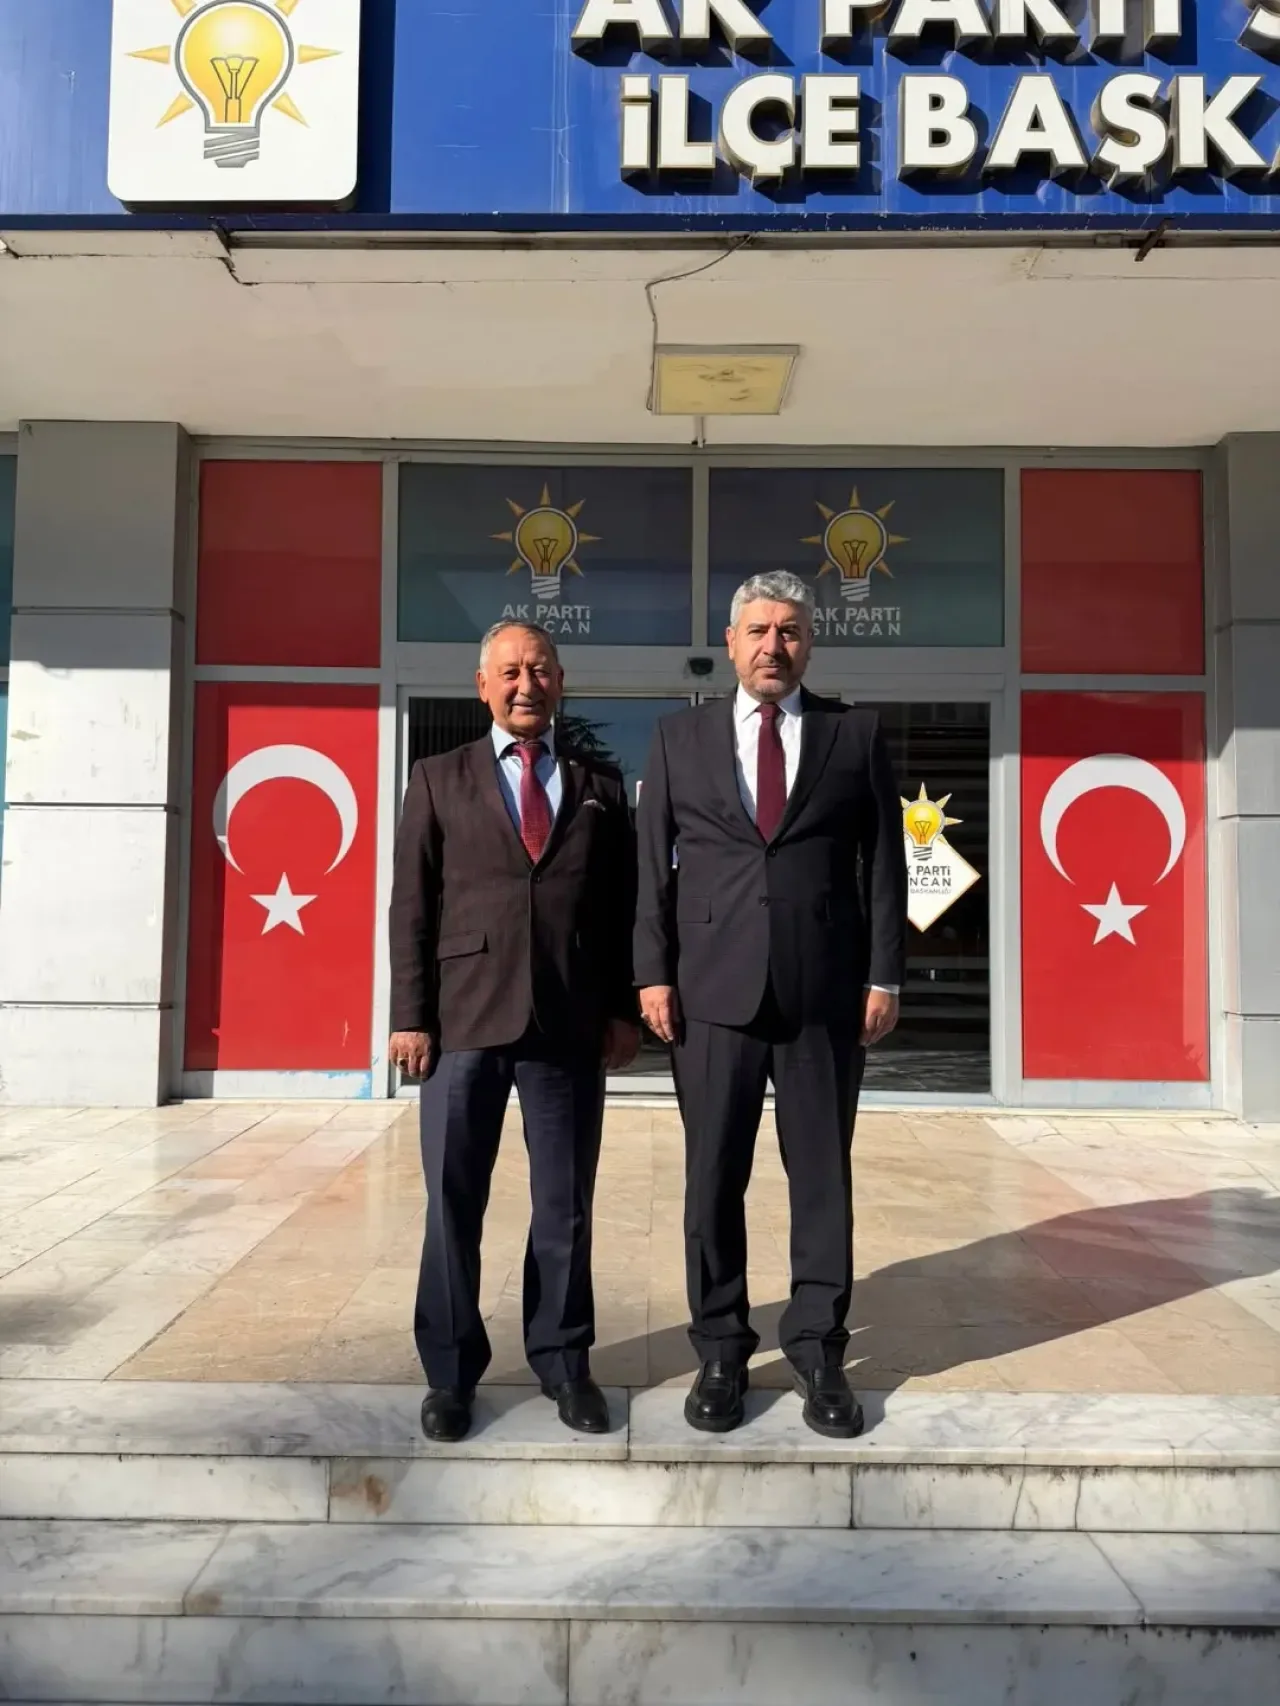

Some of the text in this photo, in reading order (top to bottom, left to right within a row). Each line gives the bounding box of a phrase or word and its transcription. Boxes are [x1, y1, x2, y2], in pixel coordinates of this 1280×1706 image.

[900, 73, 1280, 177] BAŞK
[501, 603, 529, 619] AK
[812, 607, 839, 621] AK
